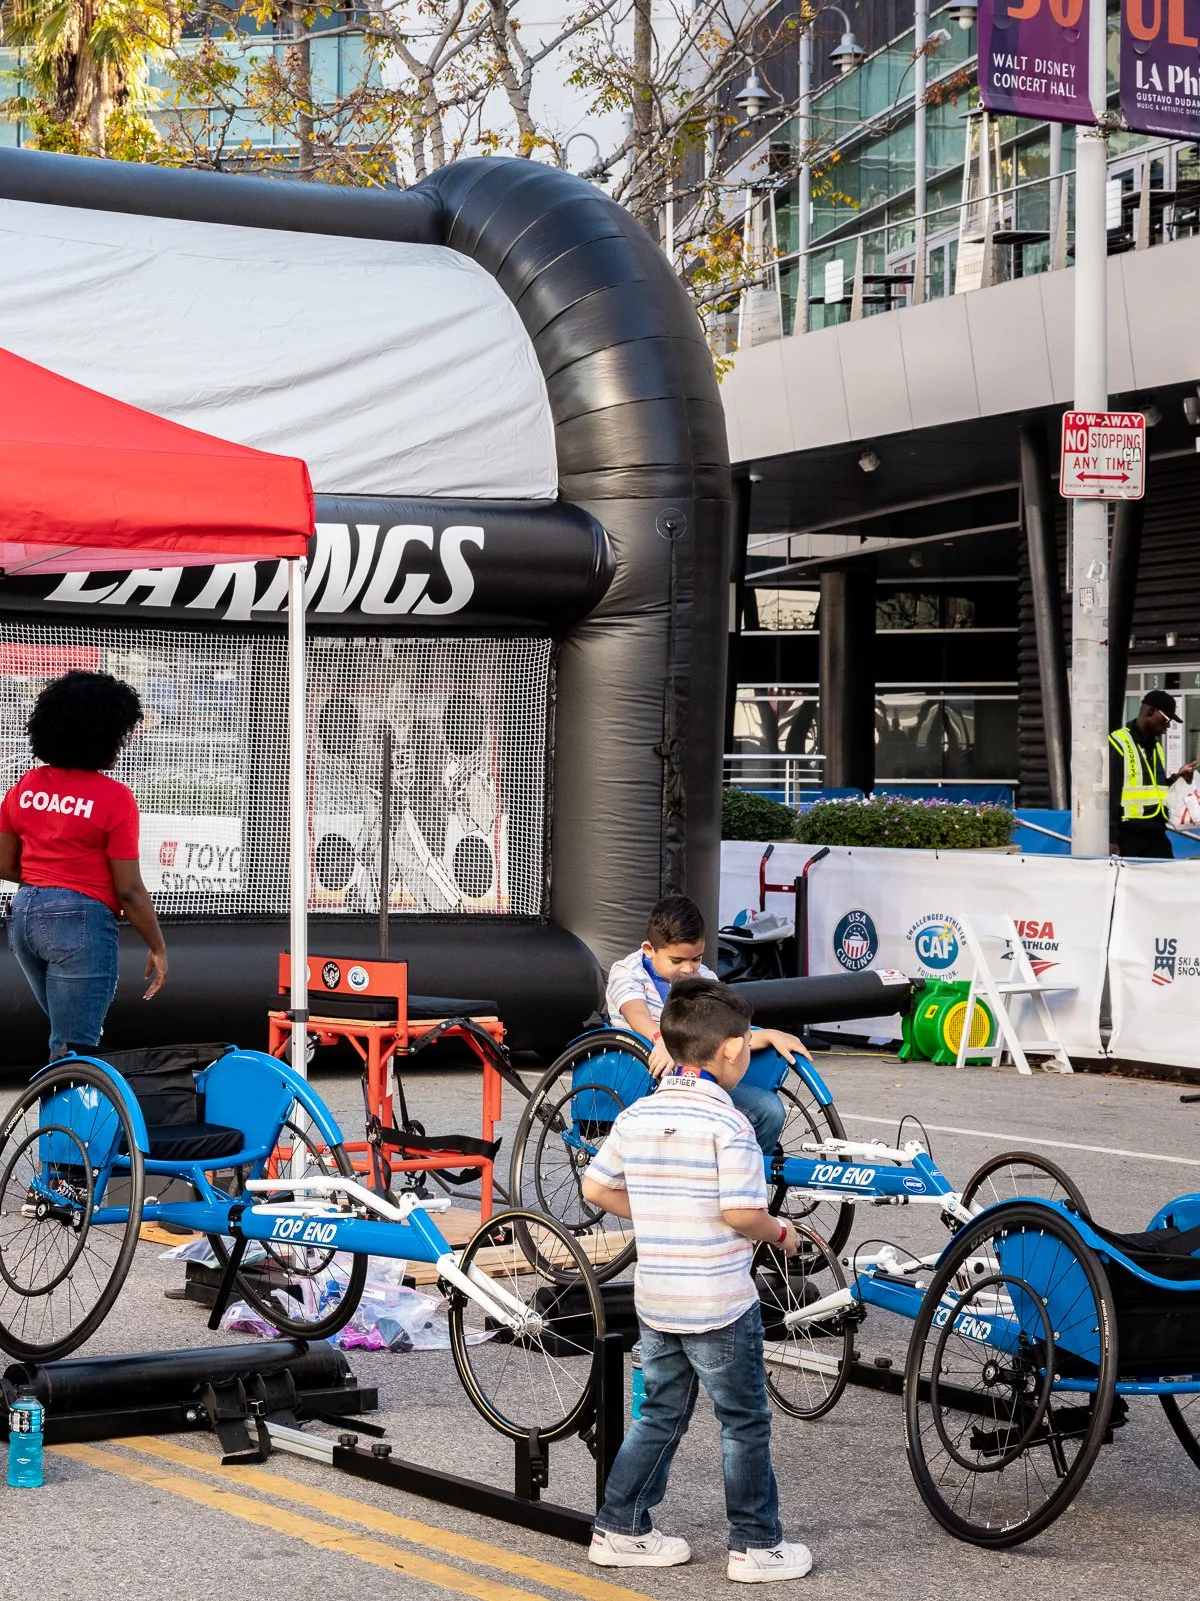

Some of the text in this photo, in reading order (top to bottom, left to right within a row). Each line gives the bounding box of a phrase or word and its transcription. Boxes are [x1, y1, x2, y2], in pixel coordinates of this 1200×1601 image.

[992, 53, 1076, 78] WALT DISNEY
[1136, 60, 1163, 91] LA
[993, 72, 1077, 98] CONCERT HALL
[1136, 92, 1172, 104] GUSTAVO
[1066, 414, 1142, 428] TOW-AWAY
[1065, 428, 1140, 452] NO STOPPING
[1073, 456, 1134, 471] ANY TIME
[1153, 676, 1160, 688] 3
[1124, 740, 1136, 778] SECURITY
[19, 790, 94, 819] COACH
[848, 912, 866, 924] USA
[906, 913, 968, 946] CHALLENGED ATHLETES
[918, 936, 954, 960] CAF
[1154, 938, 1178, 955] US
[836, 948, 874, 970] CURLING
[1178, 956, 1192, 966] SKI
[666, 1078, 697, 1088] HILFIGER
[810, 1164, 876, 1186] TOP END
[272, 1218, 338, 1243] TOP END
[960, 1314, 992, 1341] END
